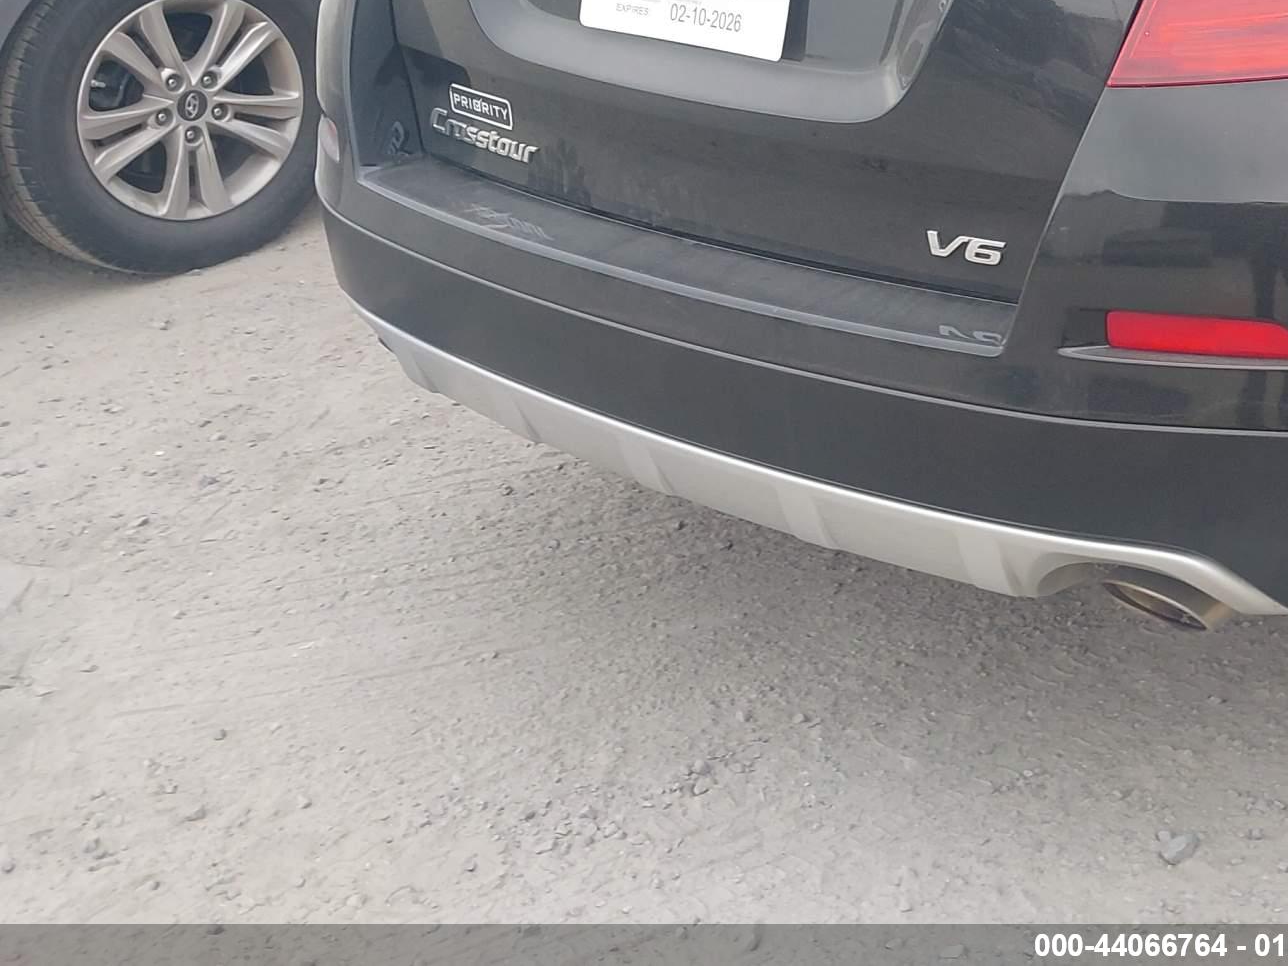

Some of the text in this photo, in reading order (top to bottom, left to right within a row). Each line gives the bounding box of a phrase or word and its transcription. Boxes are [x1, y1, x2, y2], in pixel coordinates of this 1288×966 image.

[616, 3, 649, 16] EXPIRES
[670, 2, 743, 32] 02-10-2026
[453, 92, 508, 121] PRIORITY
[926, 230, 1007, 266] V6
